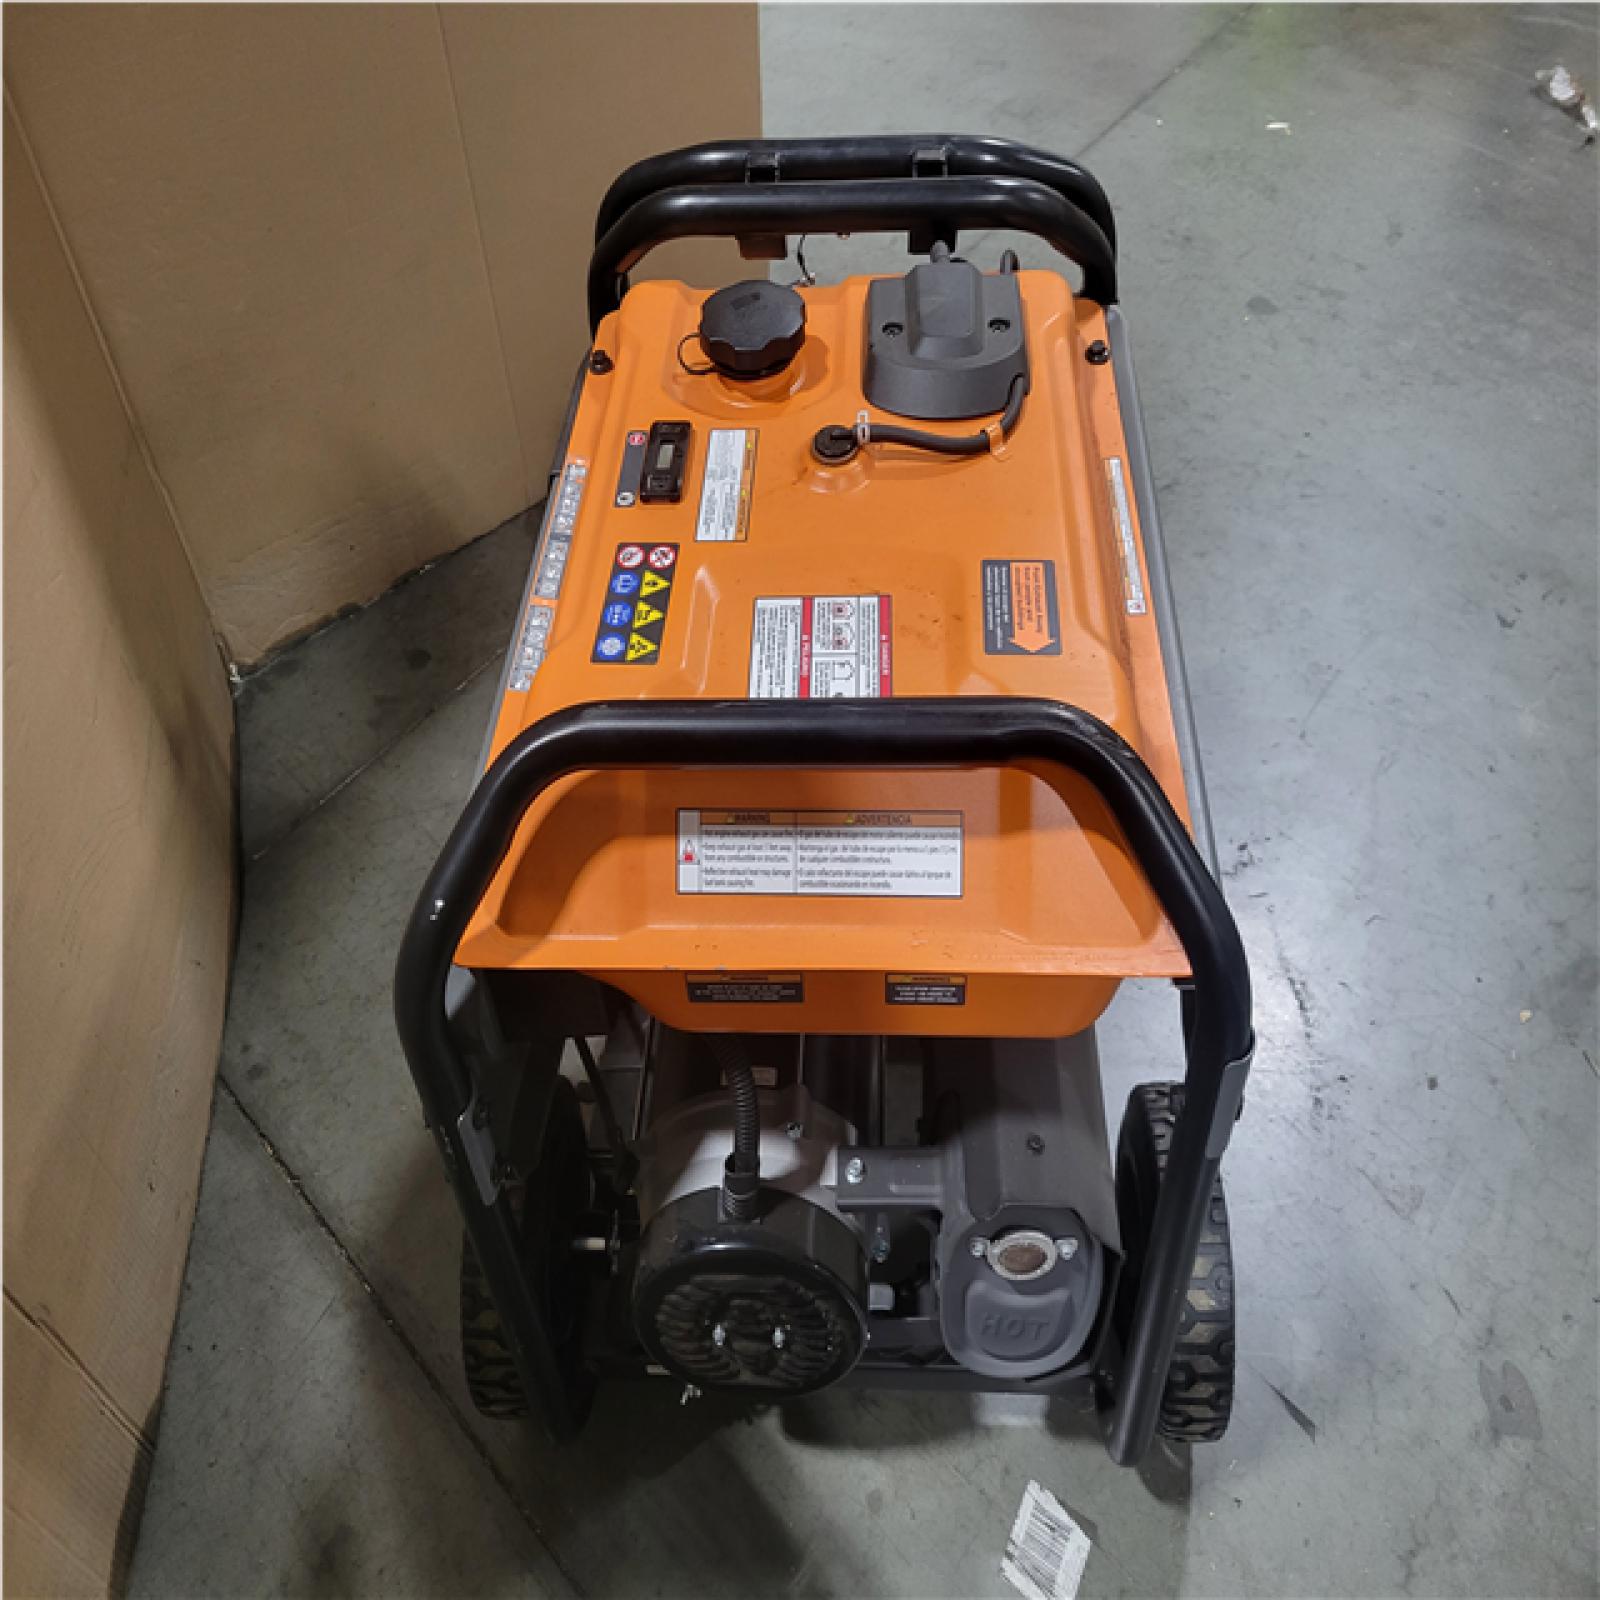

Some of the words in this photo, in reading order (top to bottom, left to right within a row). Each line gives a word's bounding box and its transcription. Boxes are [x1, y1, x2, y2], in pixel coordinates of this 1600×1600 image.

[735, 814, 770, 824] WARNING
[855, 814, 911, 825] ADVERTENCIA
[981, 1312, 1050, 1341] HOT
